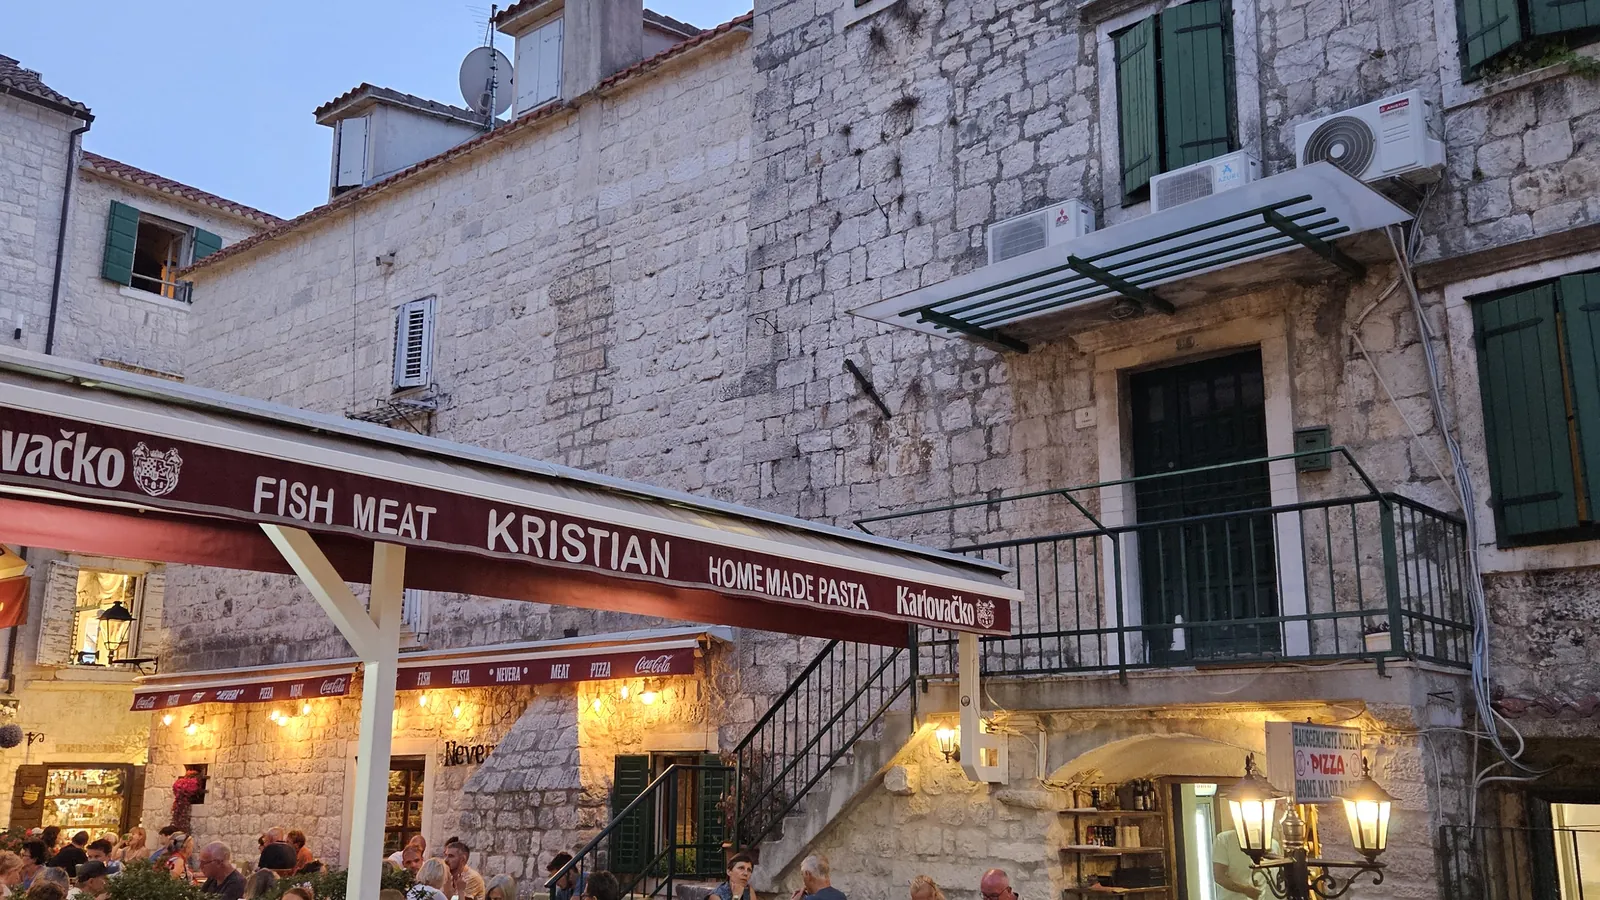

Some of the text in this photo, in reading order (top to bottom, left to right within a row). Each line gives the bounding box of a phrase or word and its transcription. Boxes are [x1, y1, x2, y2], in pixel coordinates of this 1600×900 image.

[2, 428, 125, 488] vačko
[253, 475, 437, 541] FISH MEAT
[487, 508, 670, 578] KRISTIAN
[818, 576, 869, 610] PASTA
[896, 585, 975, 626] Karlovačko
[417, 661, 611, 686] FISH PASTA NEVERA MEAT PIZZA
[444, 740, 498, 766] Never
[1310, 753, 1344, 774] PIZZA
[1297, 780, 1317, 798] HOME
